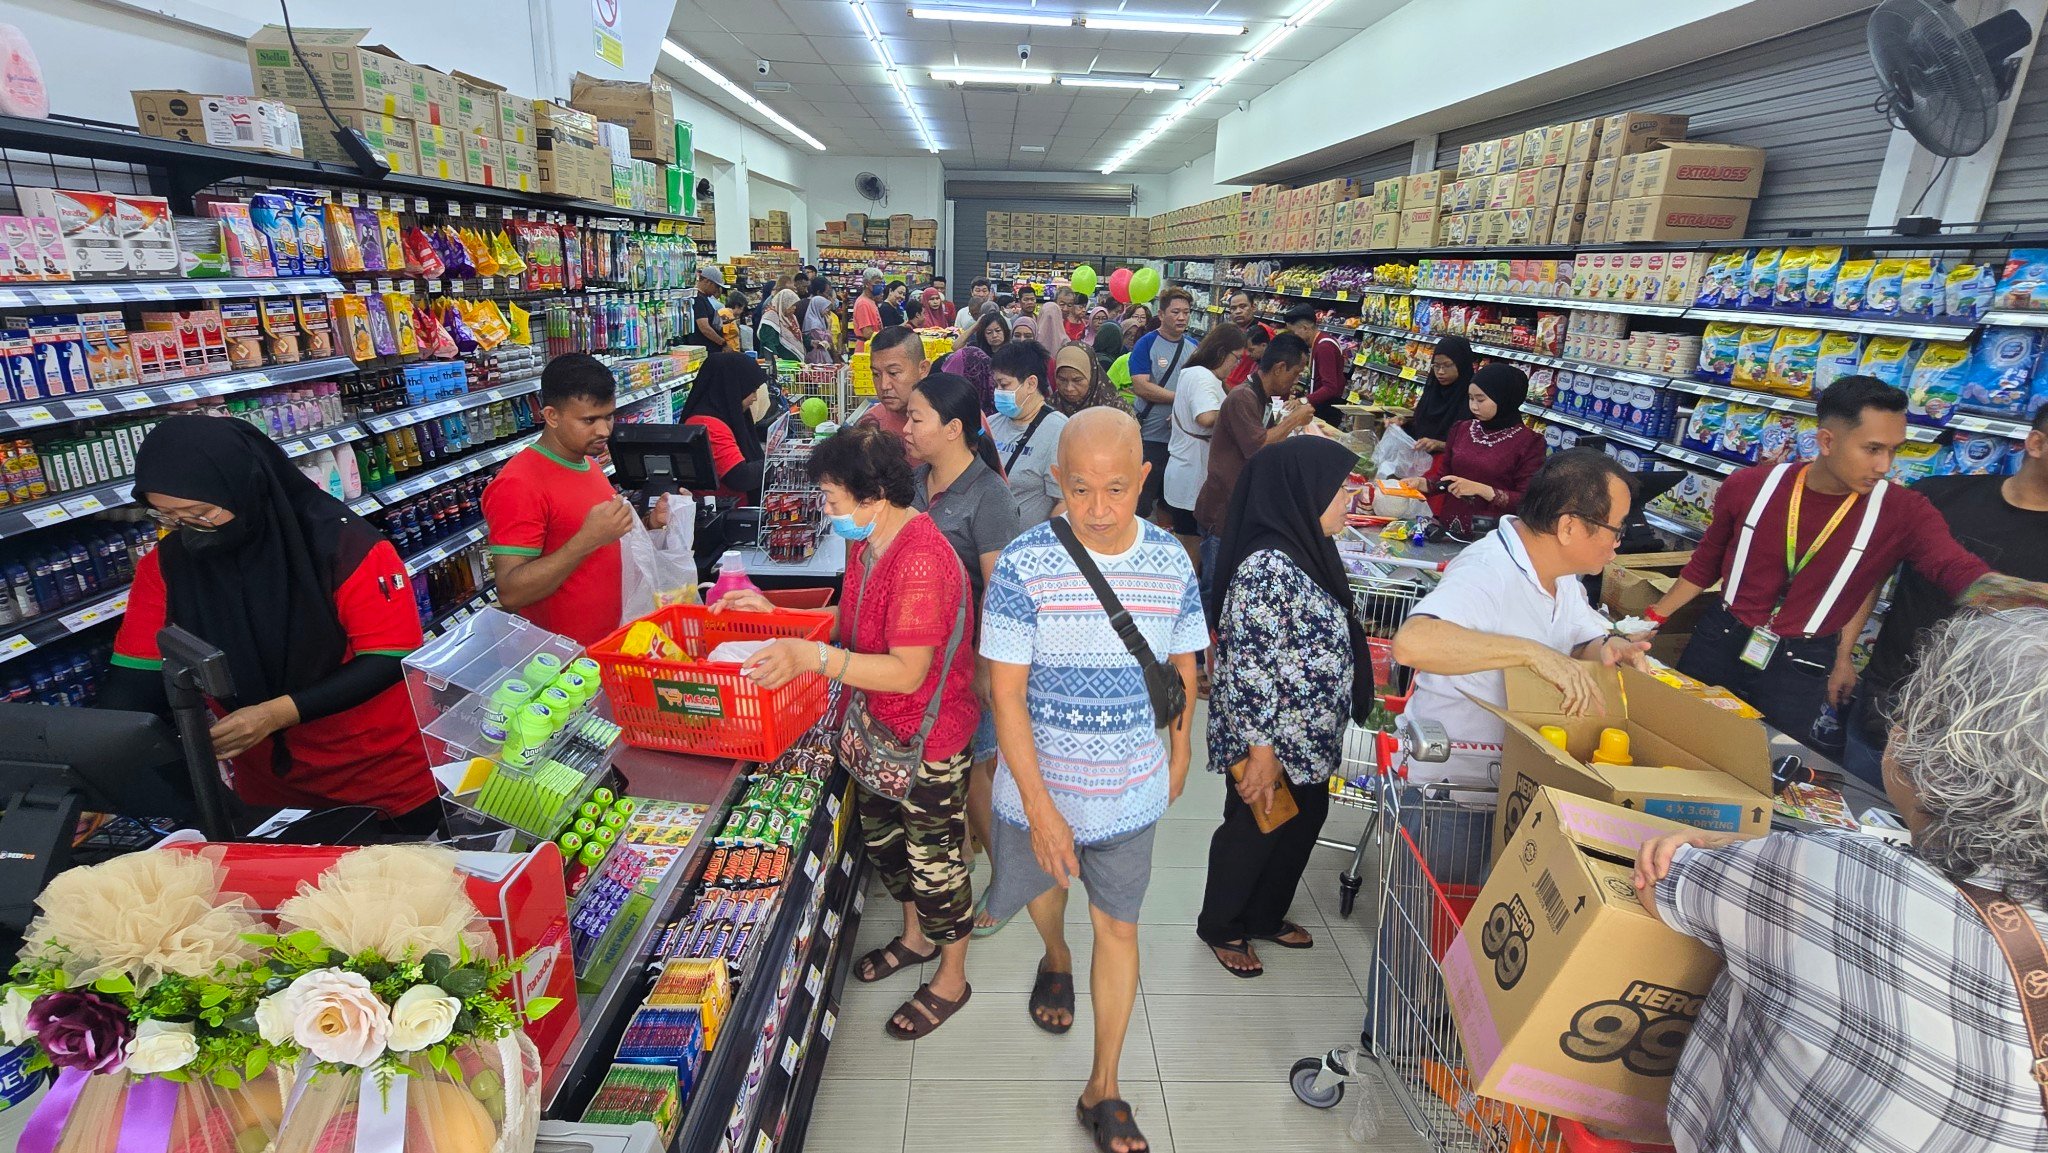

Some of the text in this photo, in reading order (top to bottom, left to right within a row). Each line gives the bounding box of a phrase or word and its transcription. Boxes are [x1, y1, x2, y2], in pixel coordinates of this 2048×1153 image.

[1666, 804, 1673, 813] 4
[1688, 806, 1720, 818] 3.6kg
[1510, 895, 1533, 940] HERO
[1482, 902, 1528, 990] 99
[527, 952, 551, 996] Panadol
